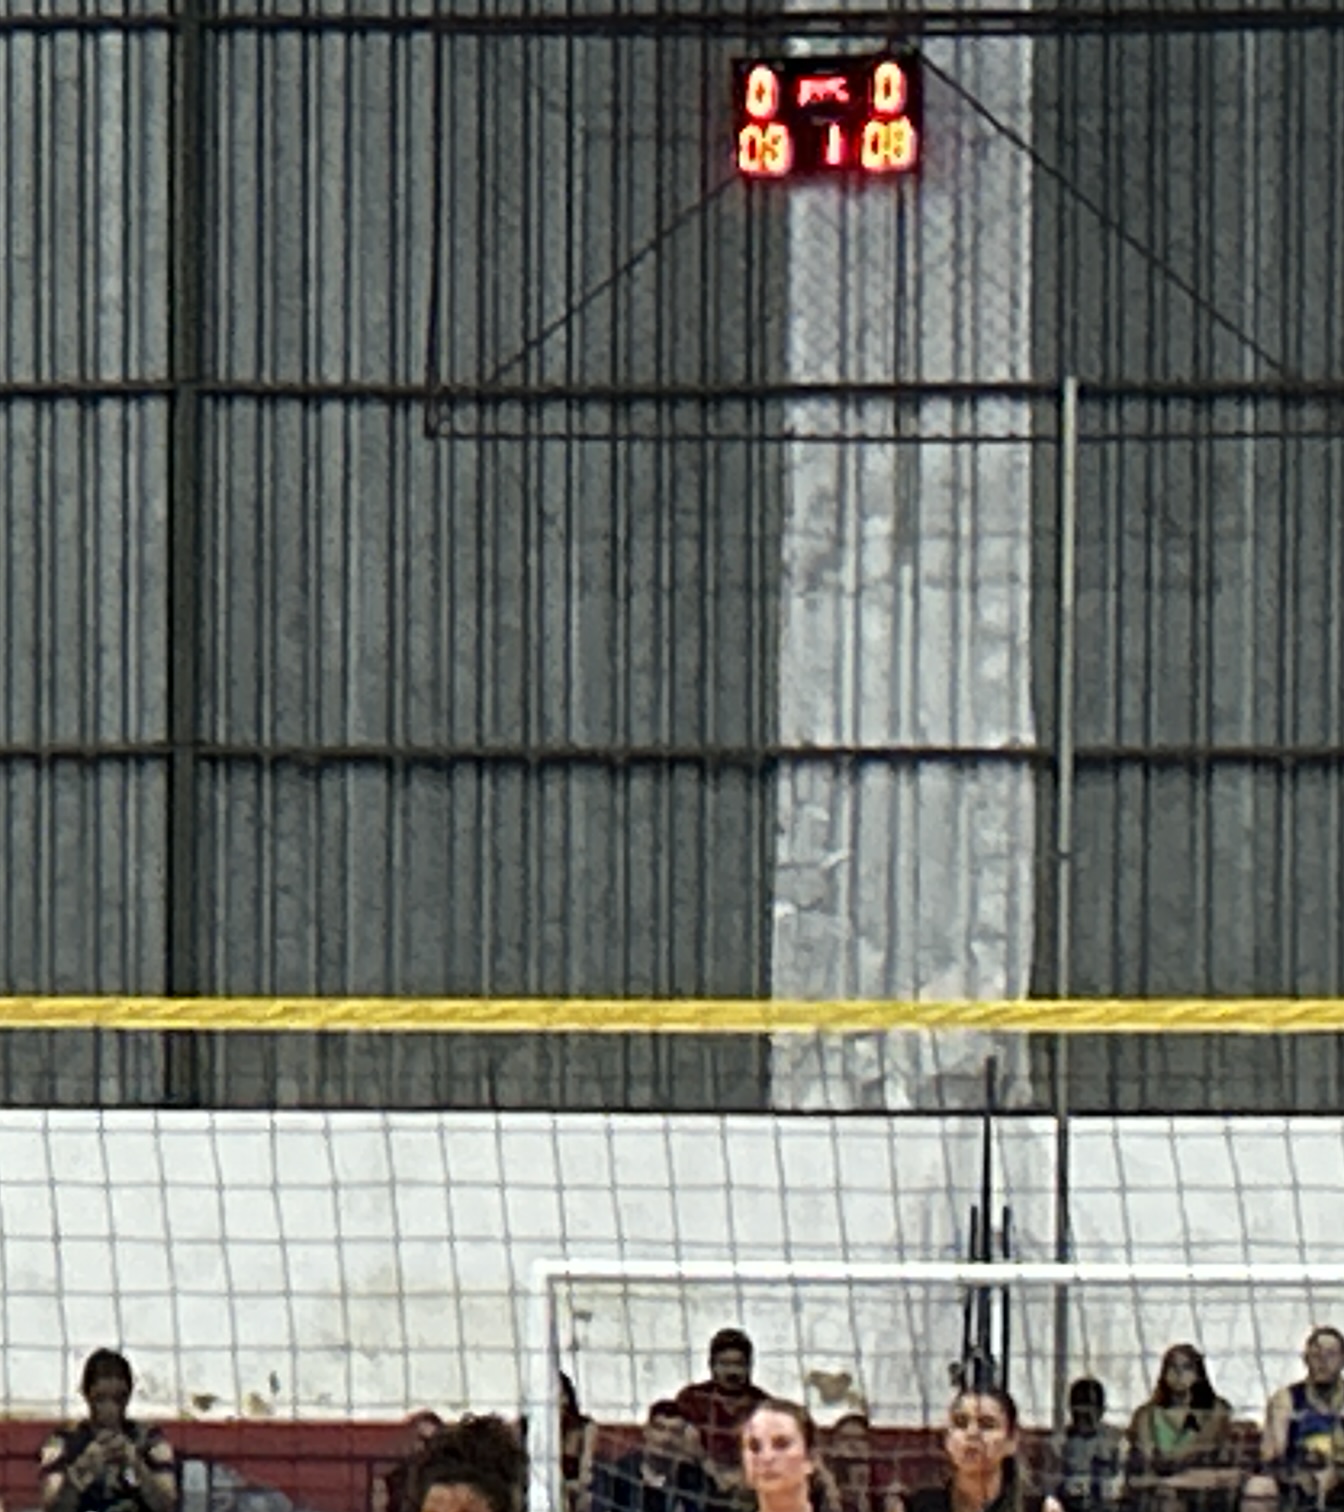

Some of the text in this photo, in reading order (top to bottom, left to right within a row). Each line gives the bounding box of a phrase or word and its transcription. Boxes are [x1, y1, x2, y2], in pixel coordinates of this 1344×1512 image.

[746, 65, 778, 117] 0
[873, 62, 906, 113] 0
[826, 122, 843, 166] 1
